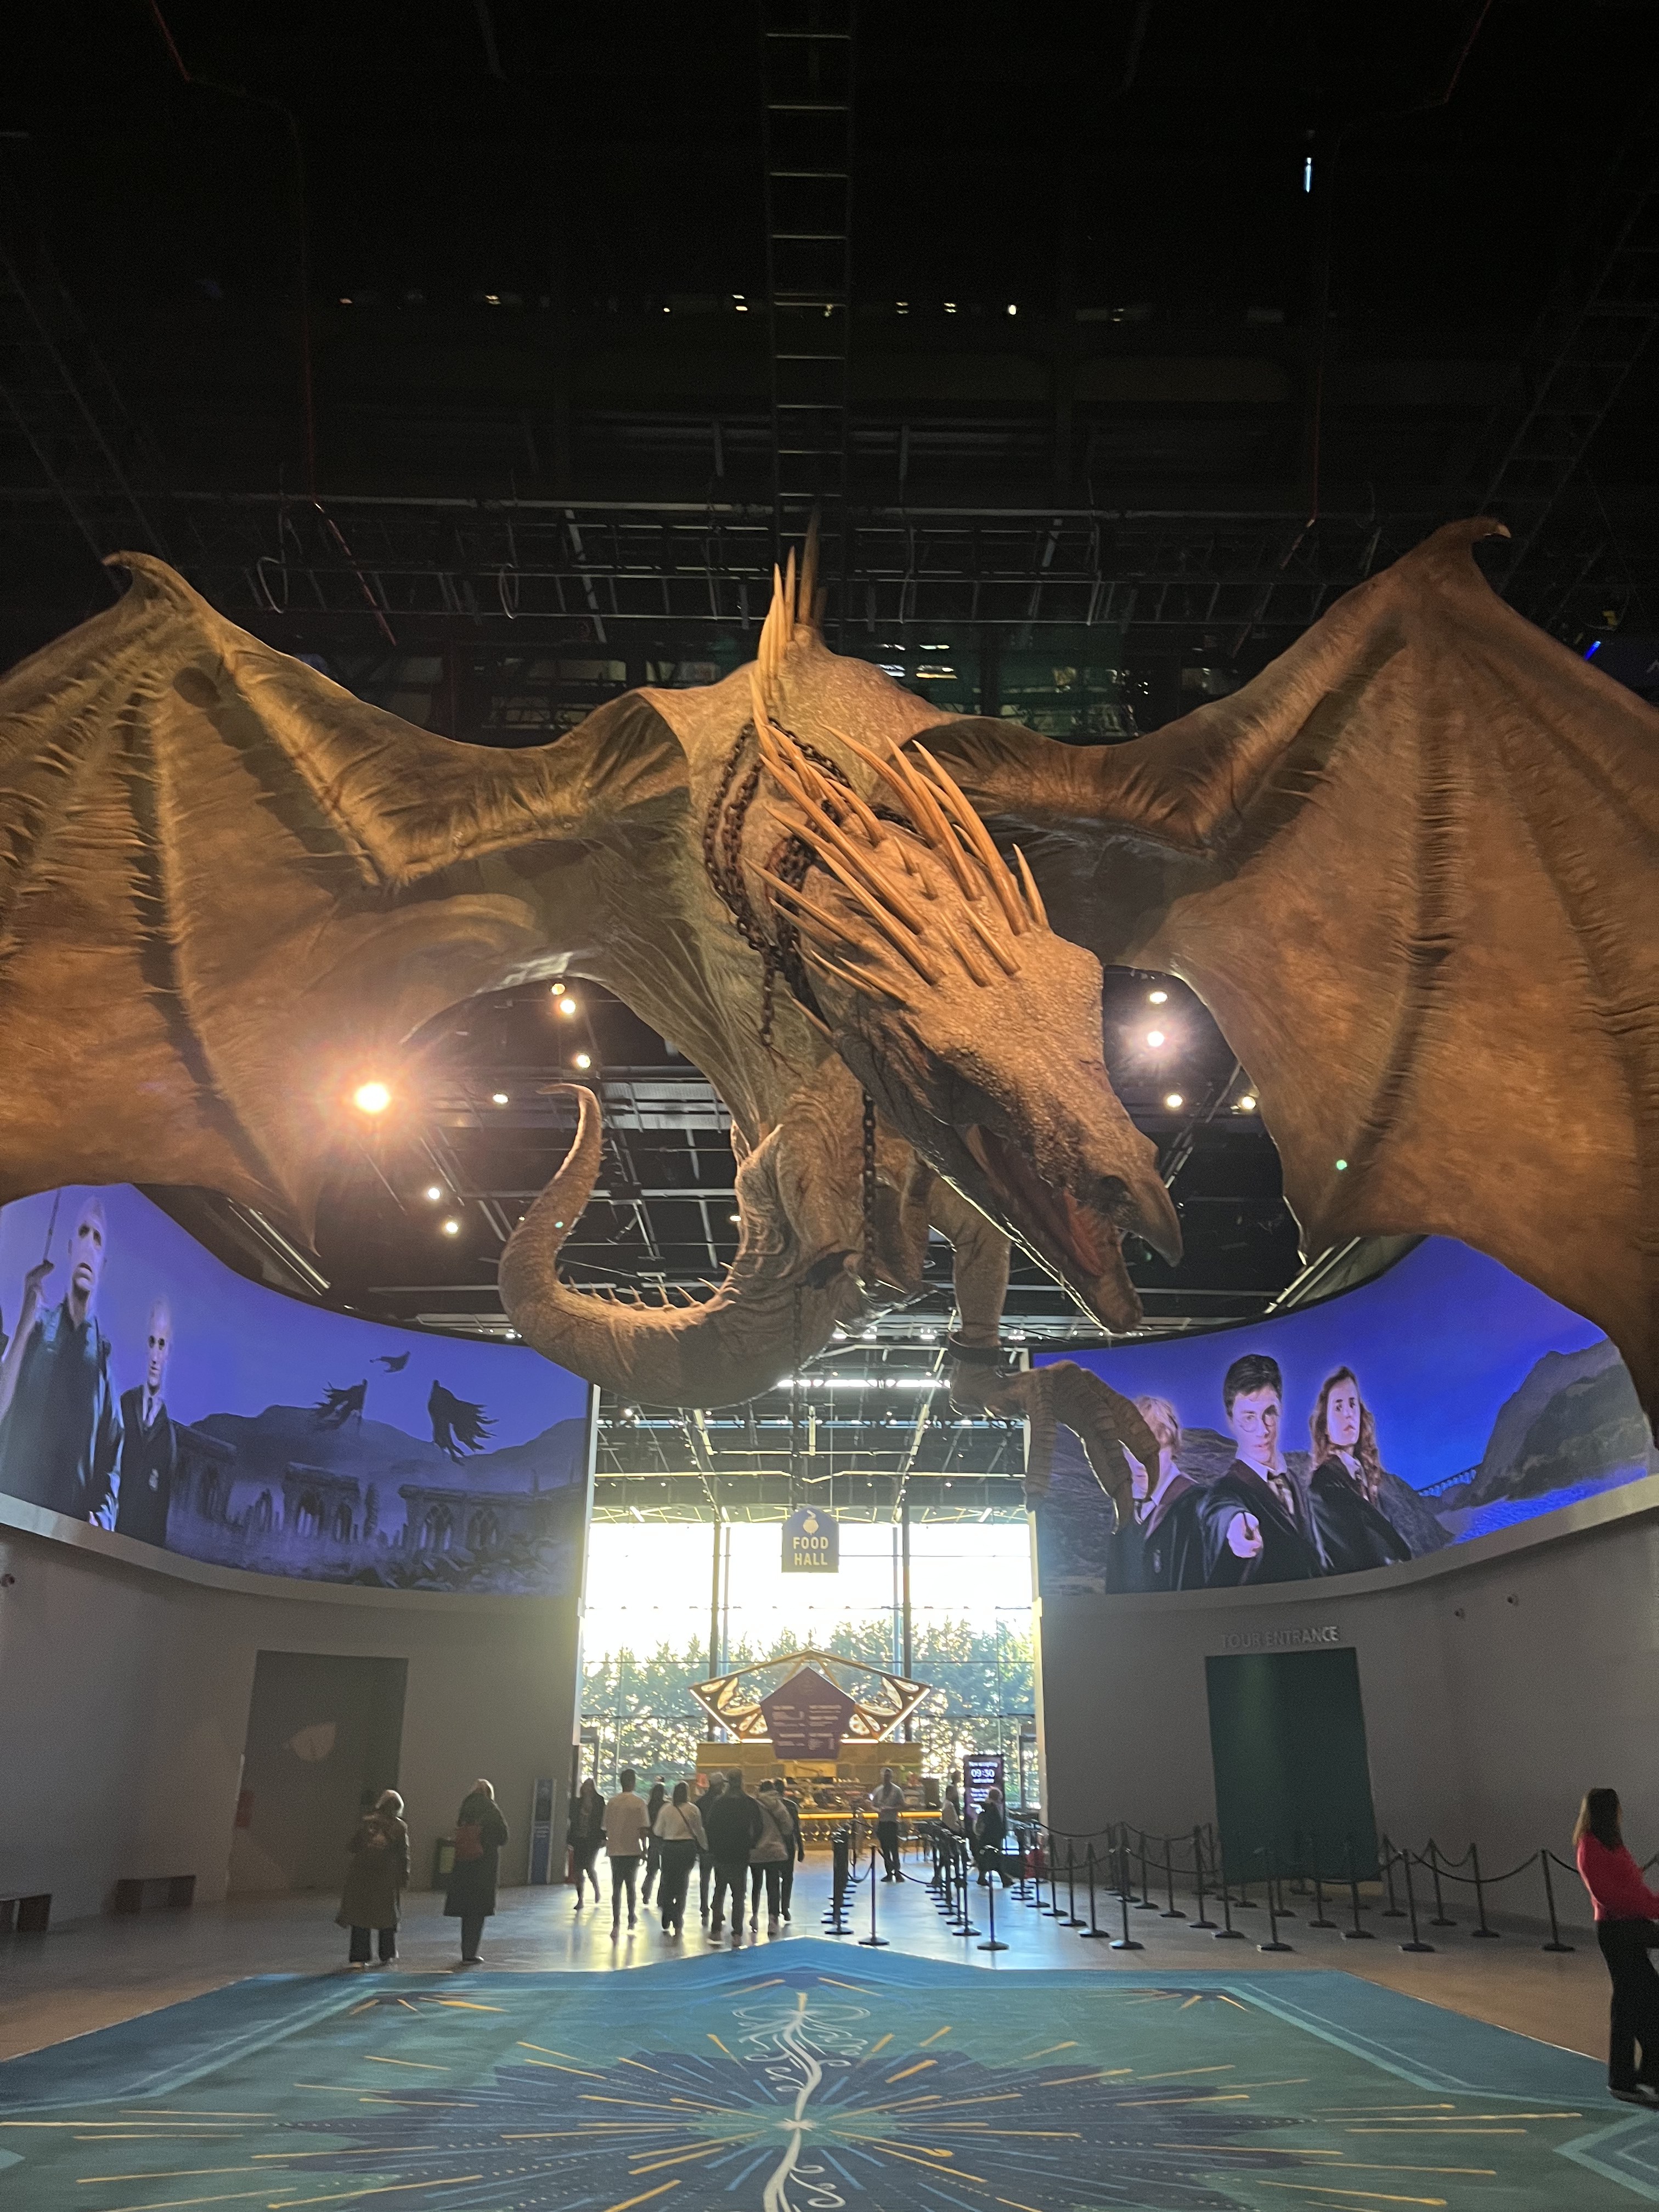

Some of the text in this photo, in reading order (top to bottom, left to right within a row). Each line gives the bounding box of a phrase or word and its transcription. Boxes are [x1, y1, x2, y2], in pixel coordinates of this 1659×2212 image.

[793, 1537, 829, 1549] FOOD
[794, 1553, 828, 1565] HALL
[1220, 1626, 1339, 1648] TOUR ENTRANCE
